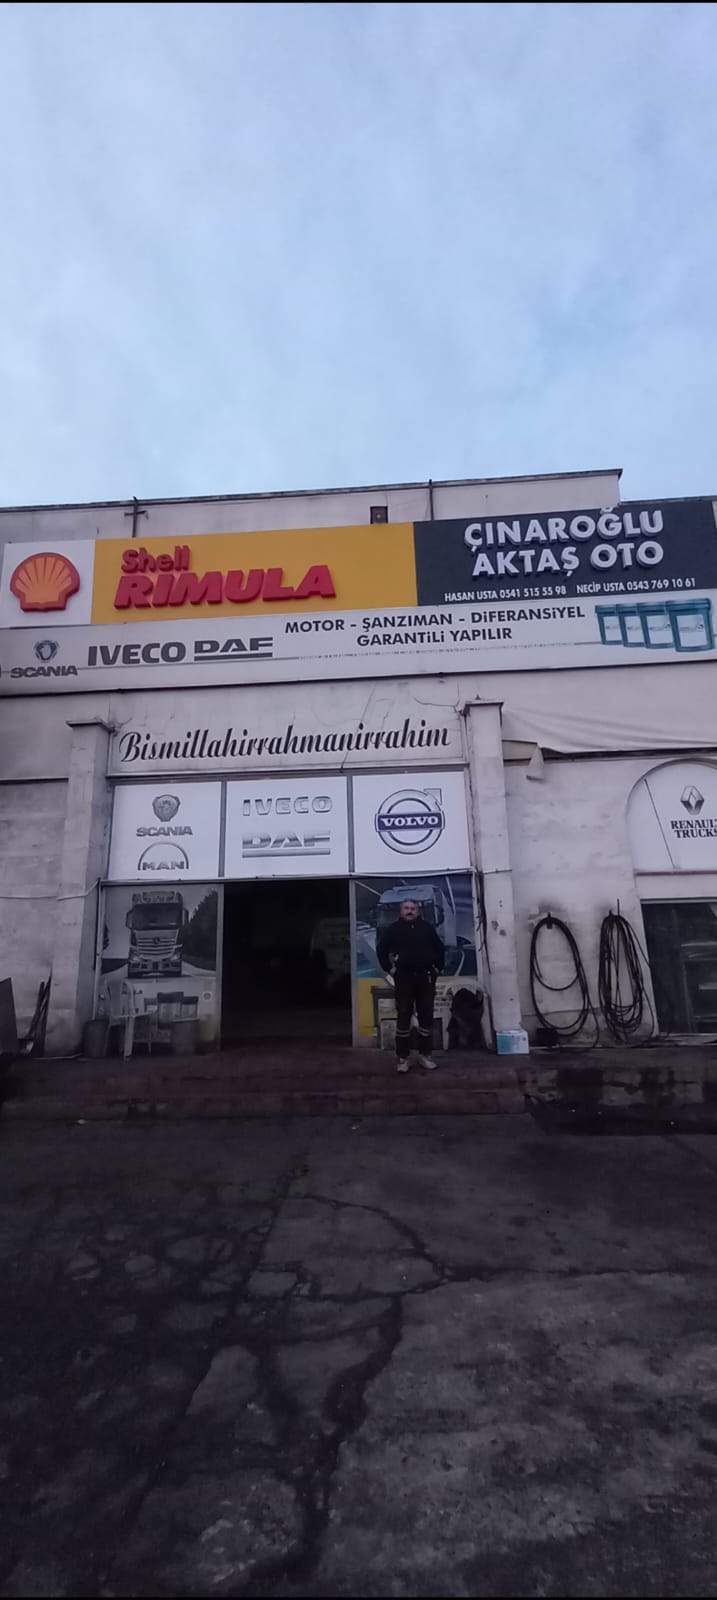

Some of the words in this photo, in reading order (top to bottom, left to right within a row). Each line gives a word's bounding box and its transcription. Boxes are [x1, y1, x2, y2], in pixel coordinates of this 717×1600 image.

[464, 507, 664, 552] ÇINAROĞLU
[121, 545, 191, 572] Shell
[472, 546, 580, 580] AKTAŞ
[590, 541, 664, 571] OTO
[114, 565, 336, 609] RIMULA
[445, 592, 474, 602] HASAN
[477, 590, 498, 600] USTA
[500, 589, 521, 599] 0541
[523, 588, 540, 597] 515
[542, 587, 554, 596] 55
[555, 586, 566, 595] 98
[577, 581, 601, 594] NECİP
[603, 582, 625, 592] USTA
[627, 580, 649, 591] 0543
[651, 579, 669, 589] 769
[672, 578, 683, 588] 10
[685, 578, 696, 587] 61
[285, 619, 345, 634] MOTOR
[362, 613, 452, 633] ŞANZIMAN
[449, 627, 512, 642] YAPILIR
[88, 641, 186, 666] IVECO
[194, 637, 273, 654] DAF
[10, 665, 78, 678] SCANIA
[119, 718, 450, 763] Bismillahirrahmanirrahim
[243, 796, 333, 816] IVECO
[381, 815, 438, 826] VOLVO
[136, 826, 193, 837] SCANIA
[242, 831, 331, 848] DAF
[142, 860, 186, 871] MAN
